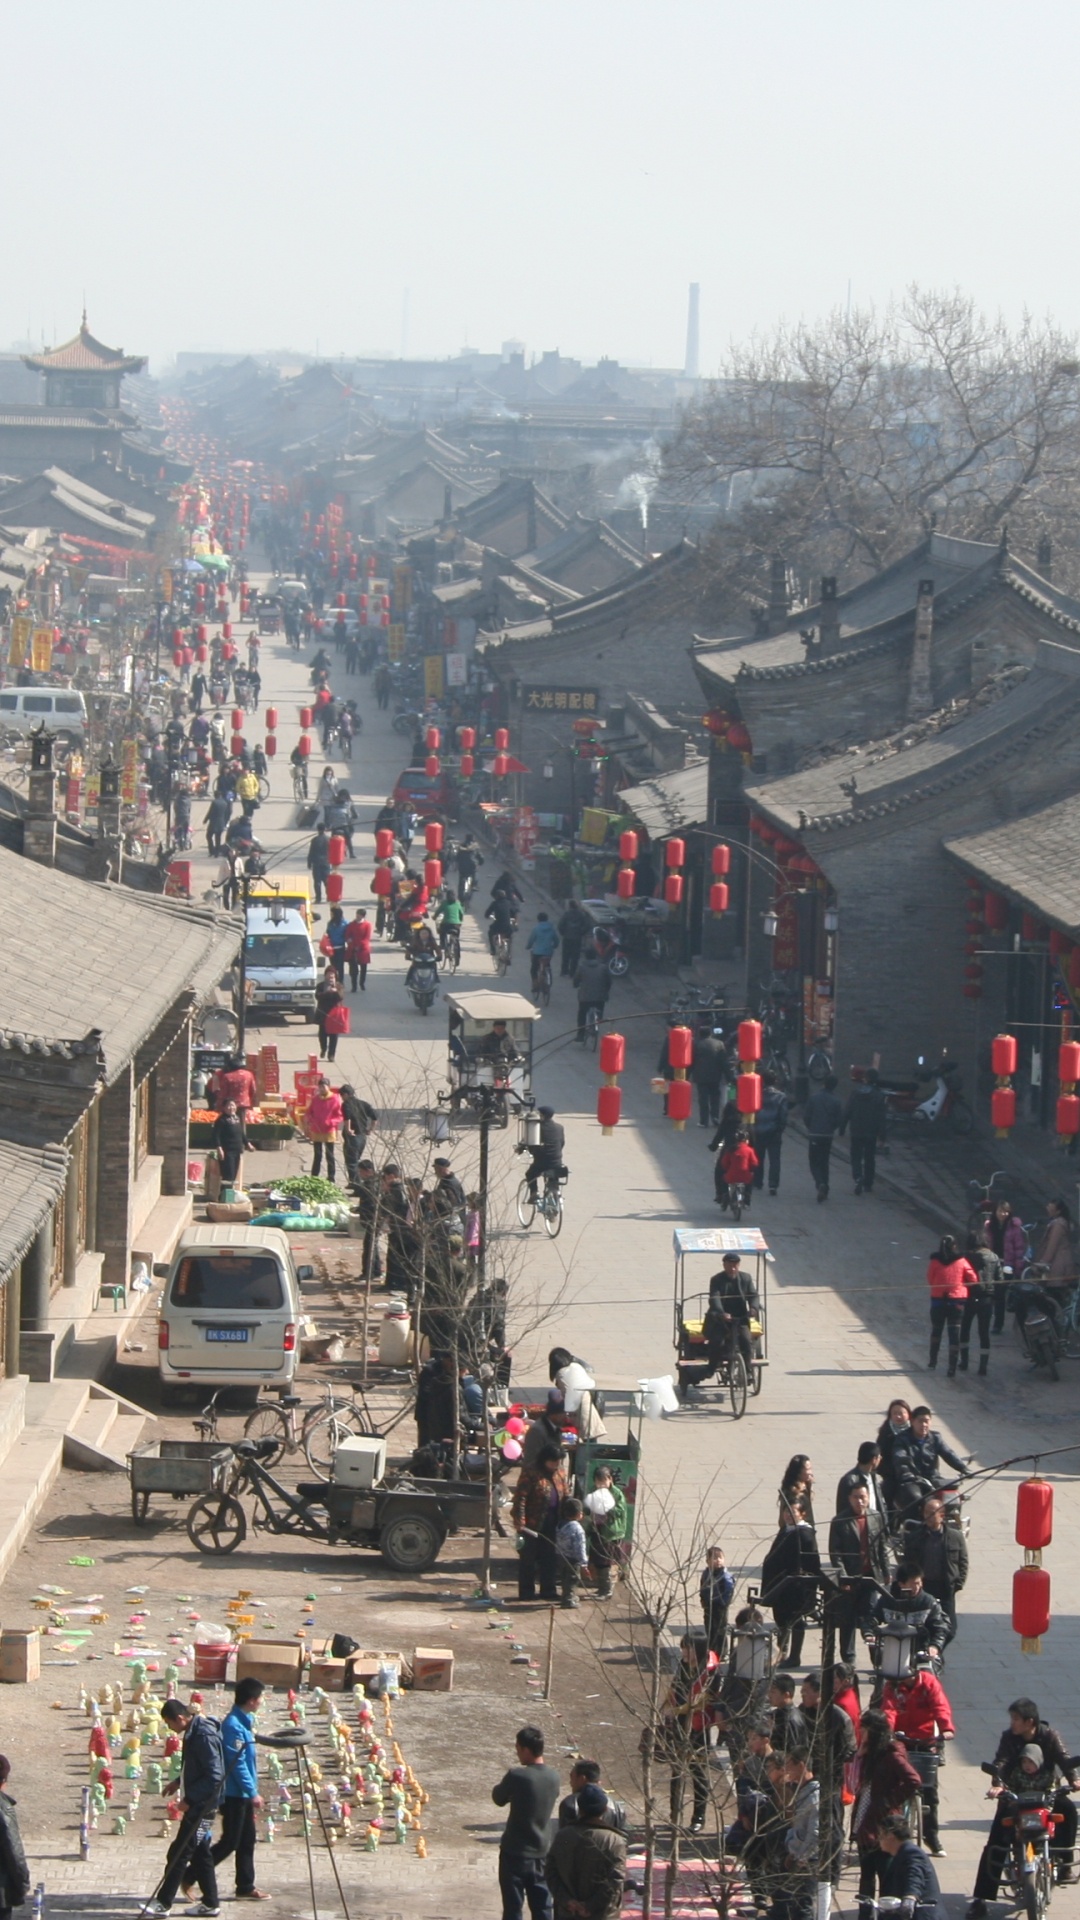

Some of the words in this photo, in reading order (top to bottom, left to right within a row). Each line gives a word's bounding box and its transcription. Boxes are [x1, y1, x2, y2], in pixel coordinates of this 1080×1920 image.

[527, 690, 596, 710] 大光明配镜
